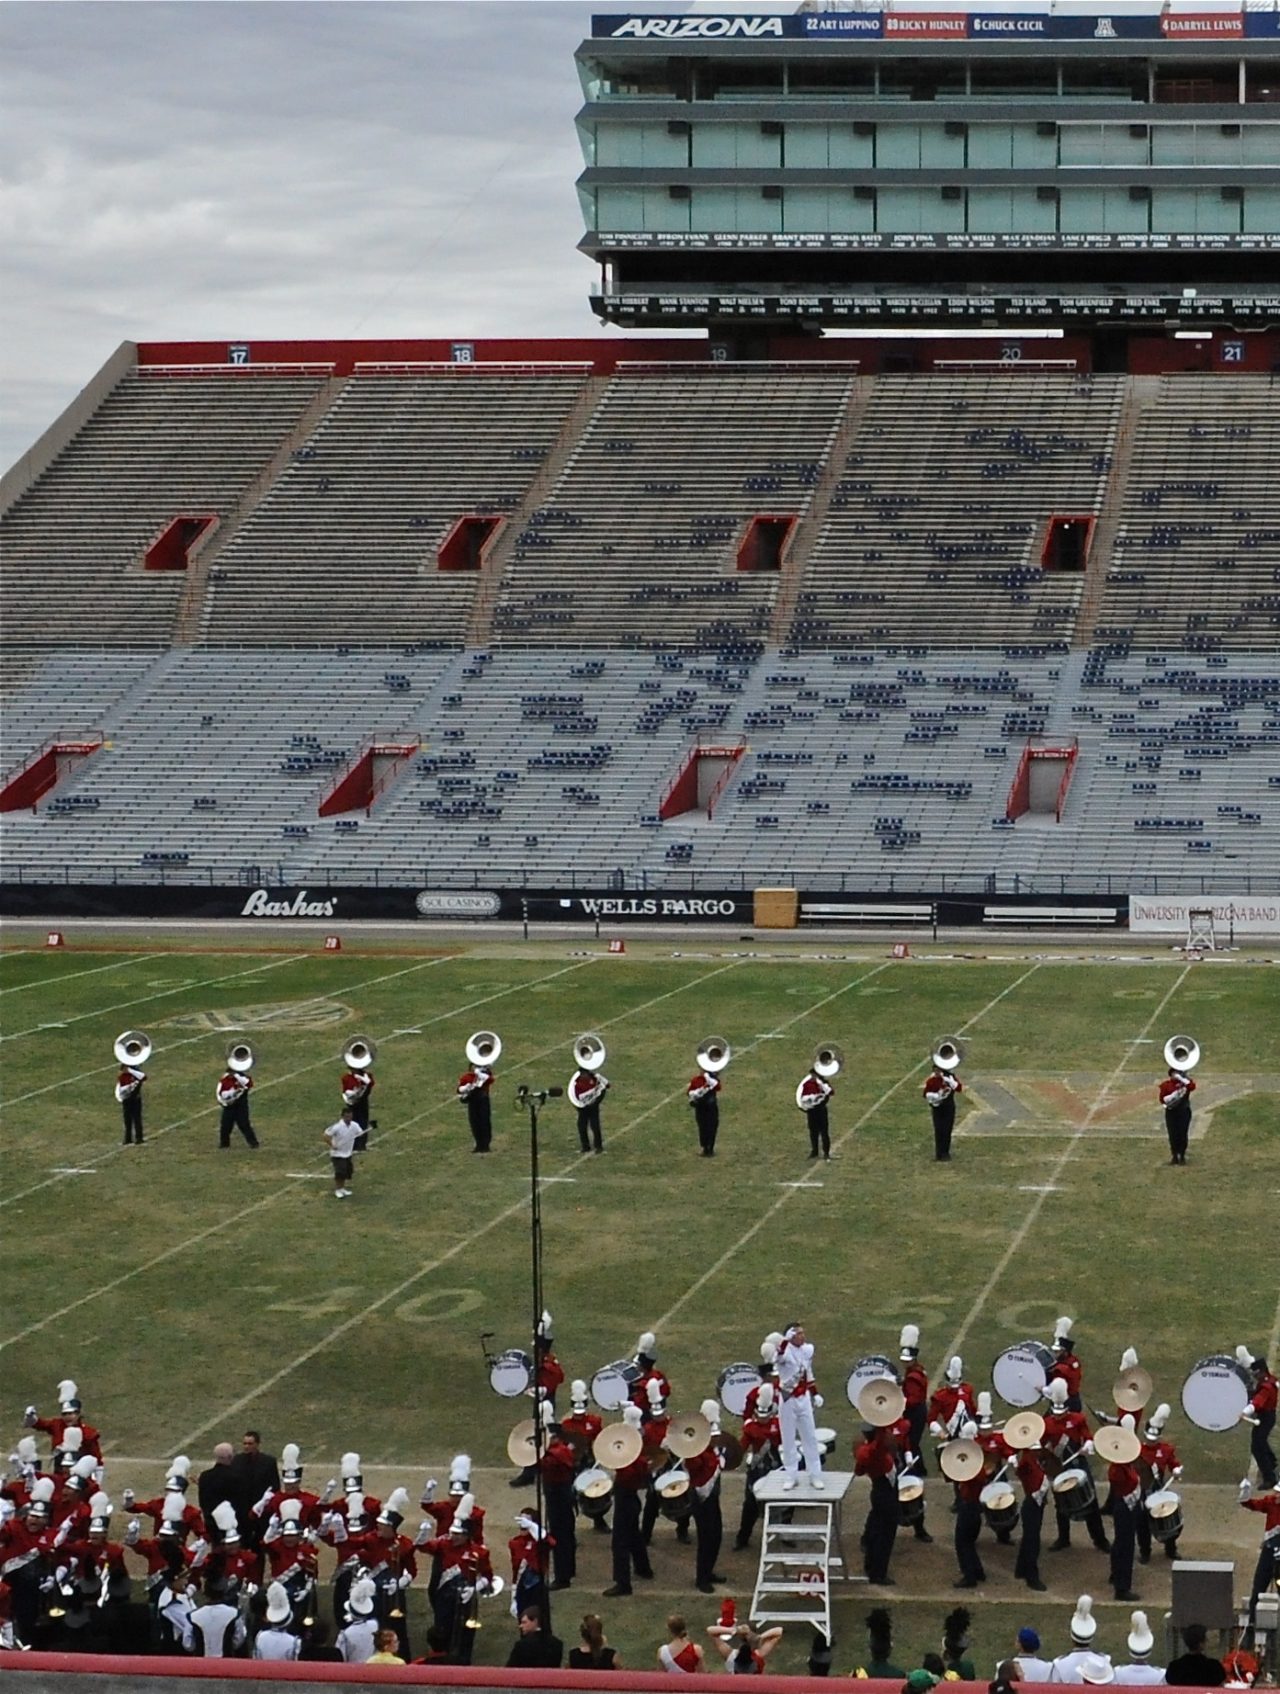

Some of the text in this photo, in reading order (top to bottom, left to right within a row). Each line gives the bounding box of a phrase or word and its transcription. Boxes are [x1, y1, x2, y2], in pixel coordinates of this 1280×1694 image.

[611, 18, 783, 38] ARIZONA
[806, 18, 880, 30] 22 ART LUPPINO
[899, 20, 927, 31] RICKY
[929, 20, 966, 32] HUNLEY
[982, 20, 1015, 31] CHUCK
[1017, 20, 1044, 31] CECIL
[1170, 21, 1212, 32] DARRYLL
[1214, 21, 1242, 31] LEWIS
[231, 351, 247, 364] 17
[454, 350, 471, 362] 18
[711, 348, 727, 361] 19
[1001, 348, 1021, 361] 20
[1224, 347, 1241, 361] 21
[241, 889, 338, 917] Bashas'
[425, 898, 492, 908] SOL CASINOS
[580, 898, 736, 916] WELLS FARGO
[1134, 906, 1186, 921] UNIVERSITY
[1249, 906, 1278, 921] BAND
